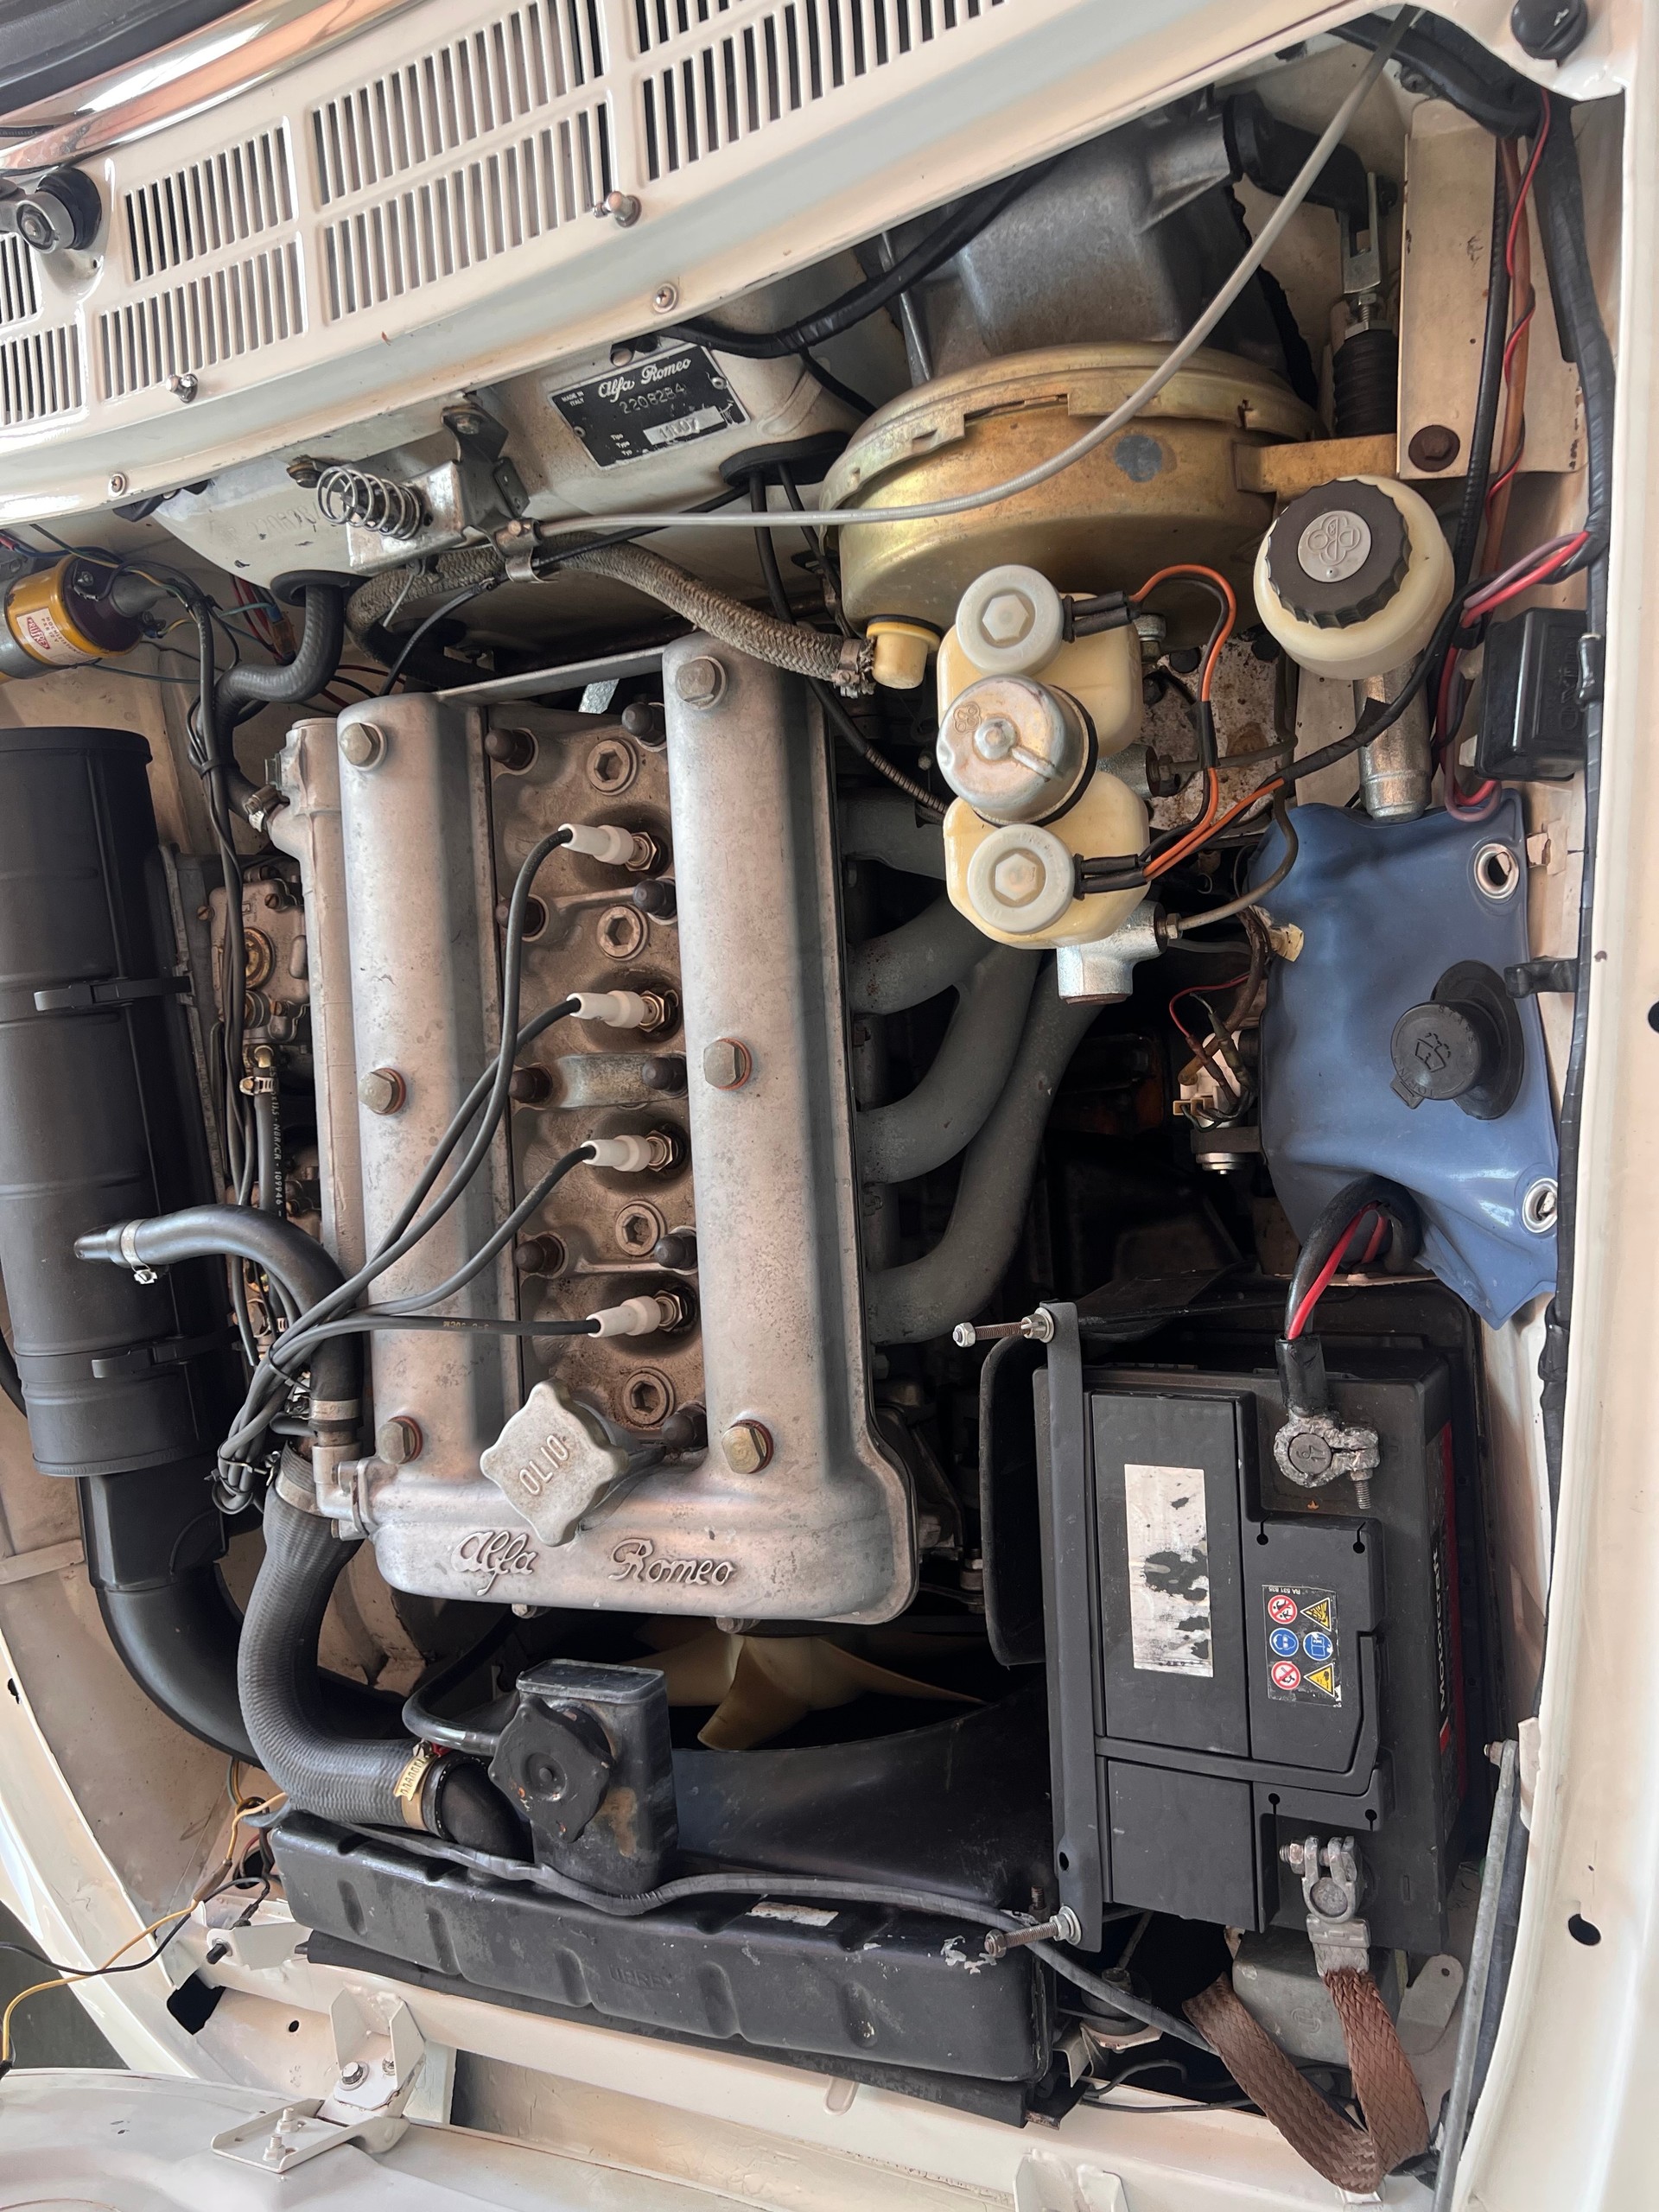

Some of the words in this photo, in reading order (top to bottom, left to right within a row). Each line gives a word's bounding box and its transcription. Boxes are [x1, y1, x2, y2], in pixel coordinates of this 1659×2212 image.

[597, 376, 635, 404] Alfa
[640, 358, 692, 385] Romeo
[619, 383, 688, 414] 2208284
[274, 1171, 283, 1205] 109946
[519, 1433, 569, 1497] OLIO
[451, 1529, 538, 1597] Alfa
[607, 1537, 737, 1586] Romeo
